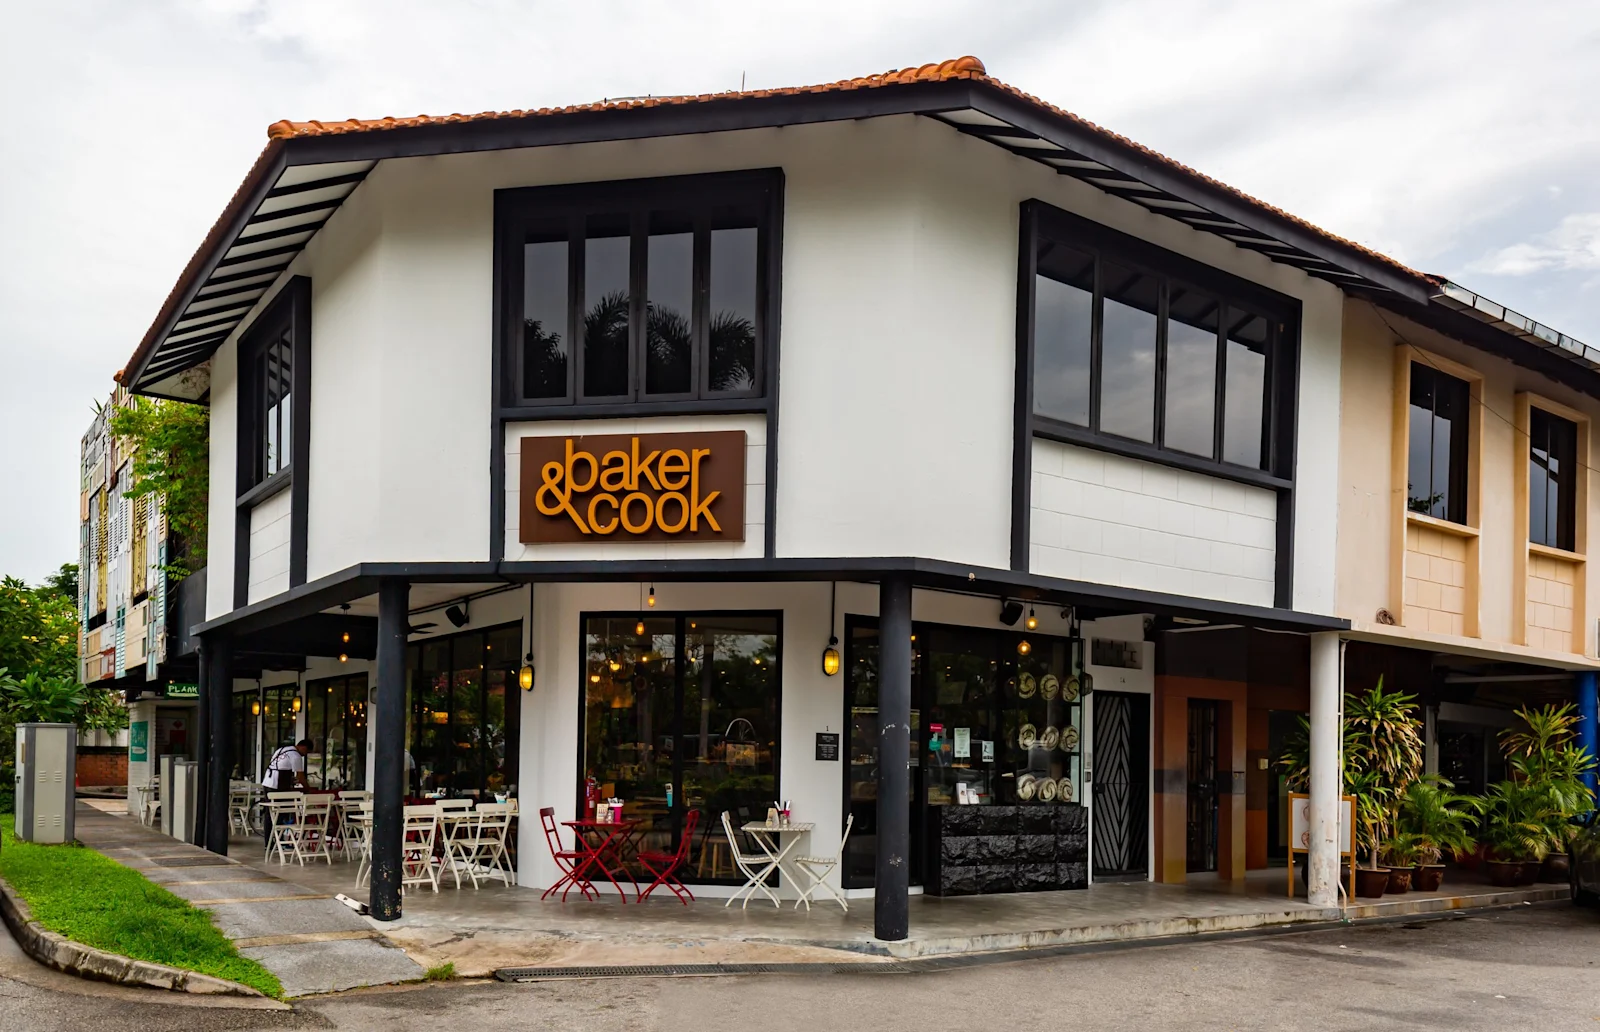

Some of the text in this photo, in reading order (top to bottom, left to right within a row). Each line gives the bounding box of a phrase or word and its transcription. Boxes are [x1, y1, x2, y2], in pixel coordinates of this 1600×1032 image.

[565, 437, 710, 493] baker
[587, 490, 722, 535] cook
[168, 685, 198, 693] PLANK
